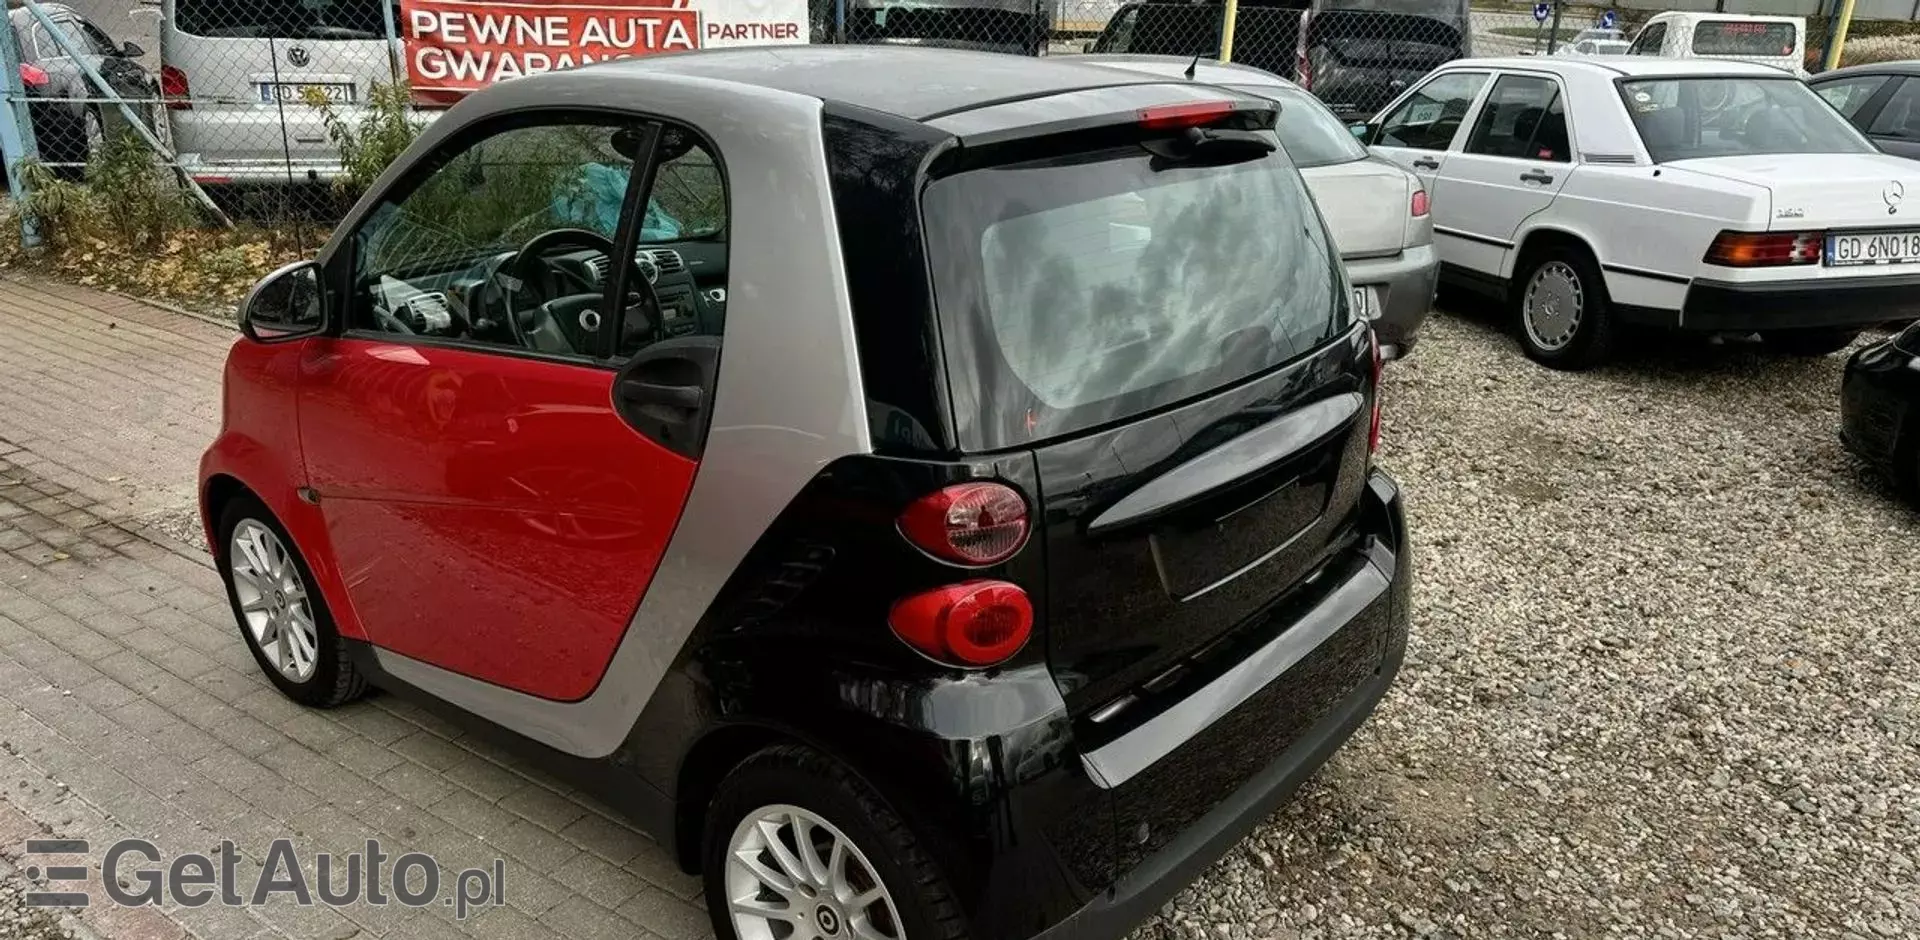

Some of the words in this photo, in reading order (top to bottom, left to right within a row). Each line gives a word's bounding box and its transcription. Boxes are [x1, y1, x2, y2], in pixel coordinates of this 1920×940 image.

[410, 9, 570, 46] PEWNE
[579, 16, 695, 49] AUTA
[707, 23, 799, 40] PARTNER
[1839, 237, 1861, 259] GD
[1867, 235, 1920, 258] 6N018
